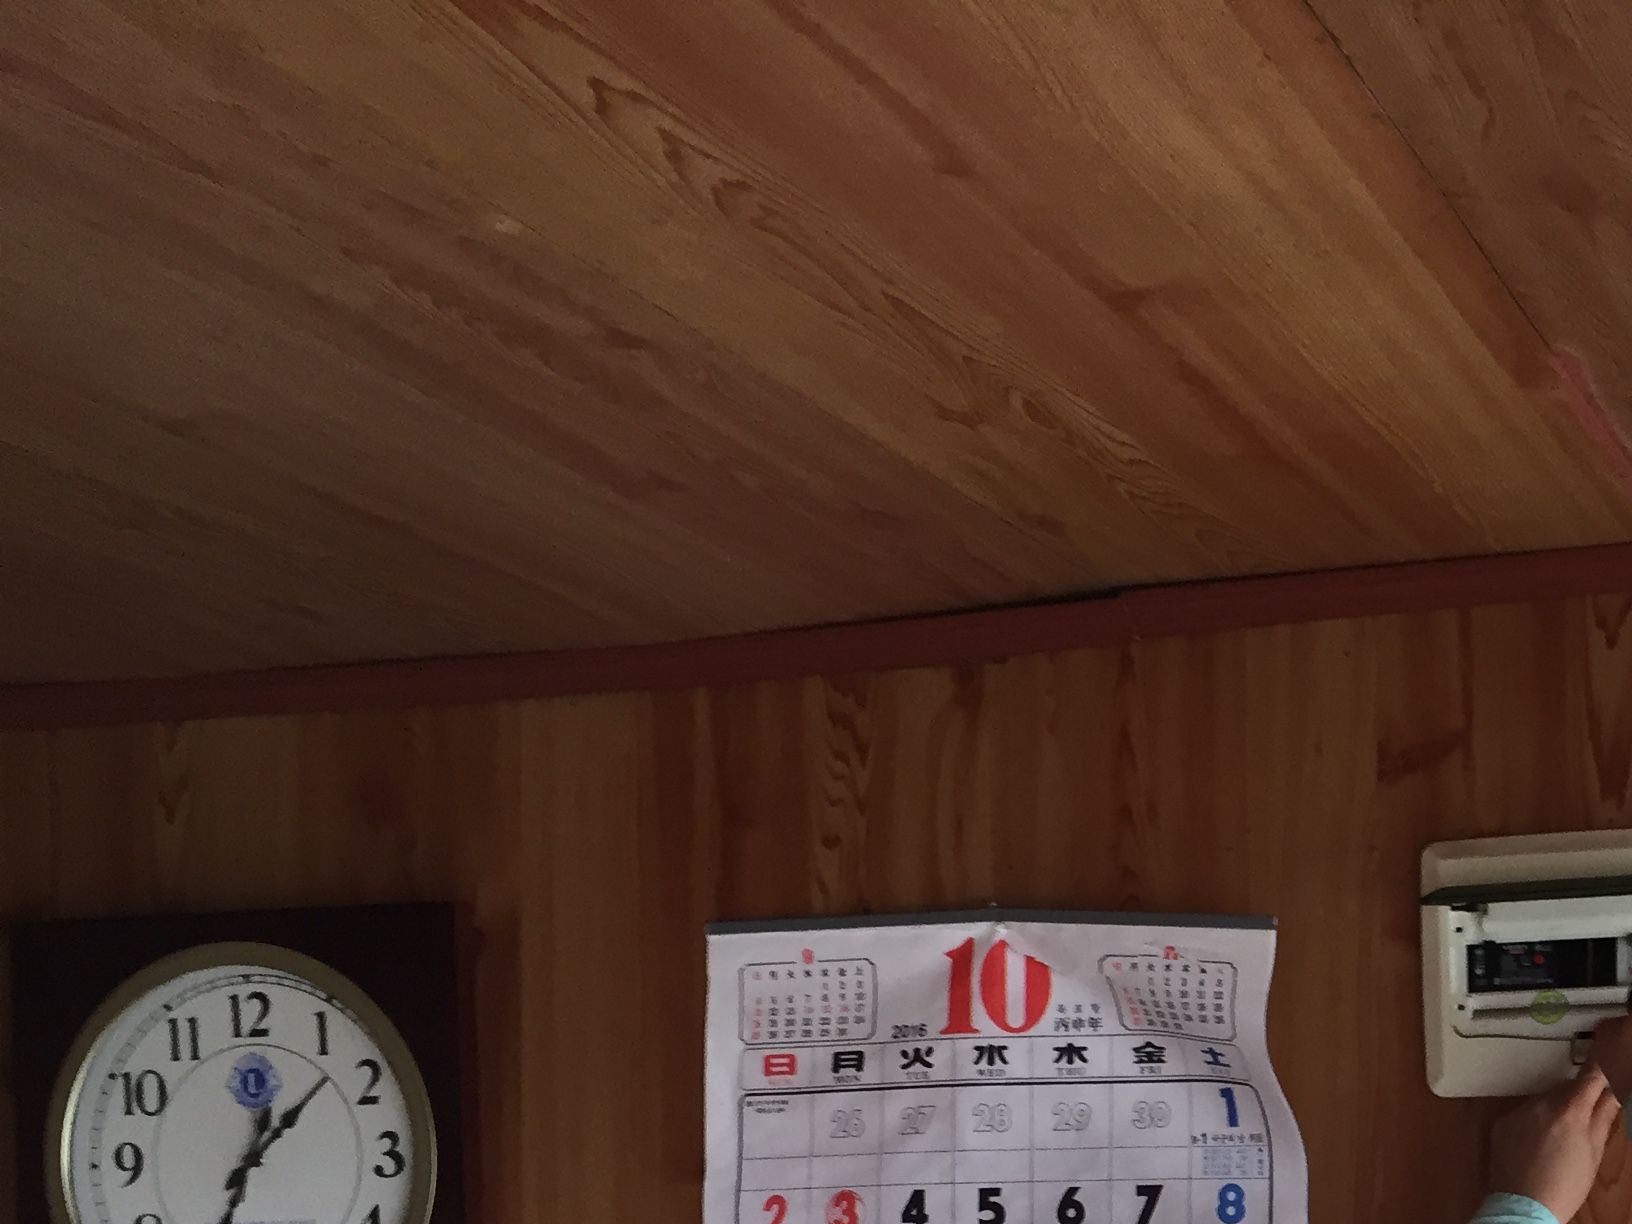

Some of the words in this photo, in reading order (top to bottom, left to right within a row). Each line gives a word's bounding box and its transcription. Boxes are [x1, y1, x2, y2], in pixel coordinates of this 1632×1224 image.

[939, 937, 1053, 1035] 10
[228, 991, 271, 1038] 12
[314, 1011, 329, 1055] 1
[168, 1017, 201, 1061] 11
[763, 1053, 797, 1076] 日
[831, 1050, 865, 1073] 月
[900, 1046, 934, 1069] 火
[973, 1044, 1009, 1066] 水
[1053, 1043, 1088, 1064] 木
[1132, 1041, 1168, 1064] 金
[1201, 1047, 1232, 1067] 土
[122, 1069, 168, 1116] 10
[357, 1059, 382, 1105] 2
[829, 1108, 866, 1138] 26
[899, 1105, 936, 1135] 27
[972, 1103, 1013, 1132] 28
[1052, 1102, 1092, 1131] 29
[1131, 1100, 1172, 1130] 30
[1219, 1087, 1240, 1127] 1
[113, 1142, 144, 1187] 9
[374, 1131, 405, 1178] 3
[1216, 1183, 1246, 1224] 8
